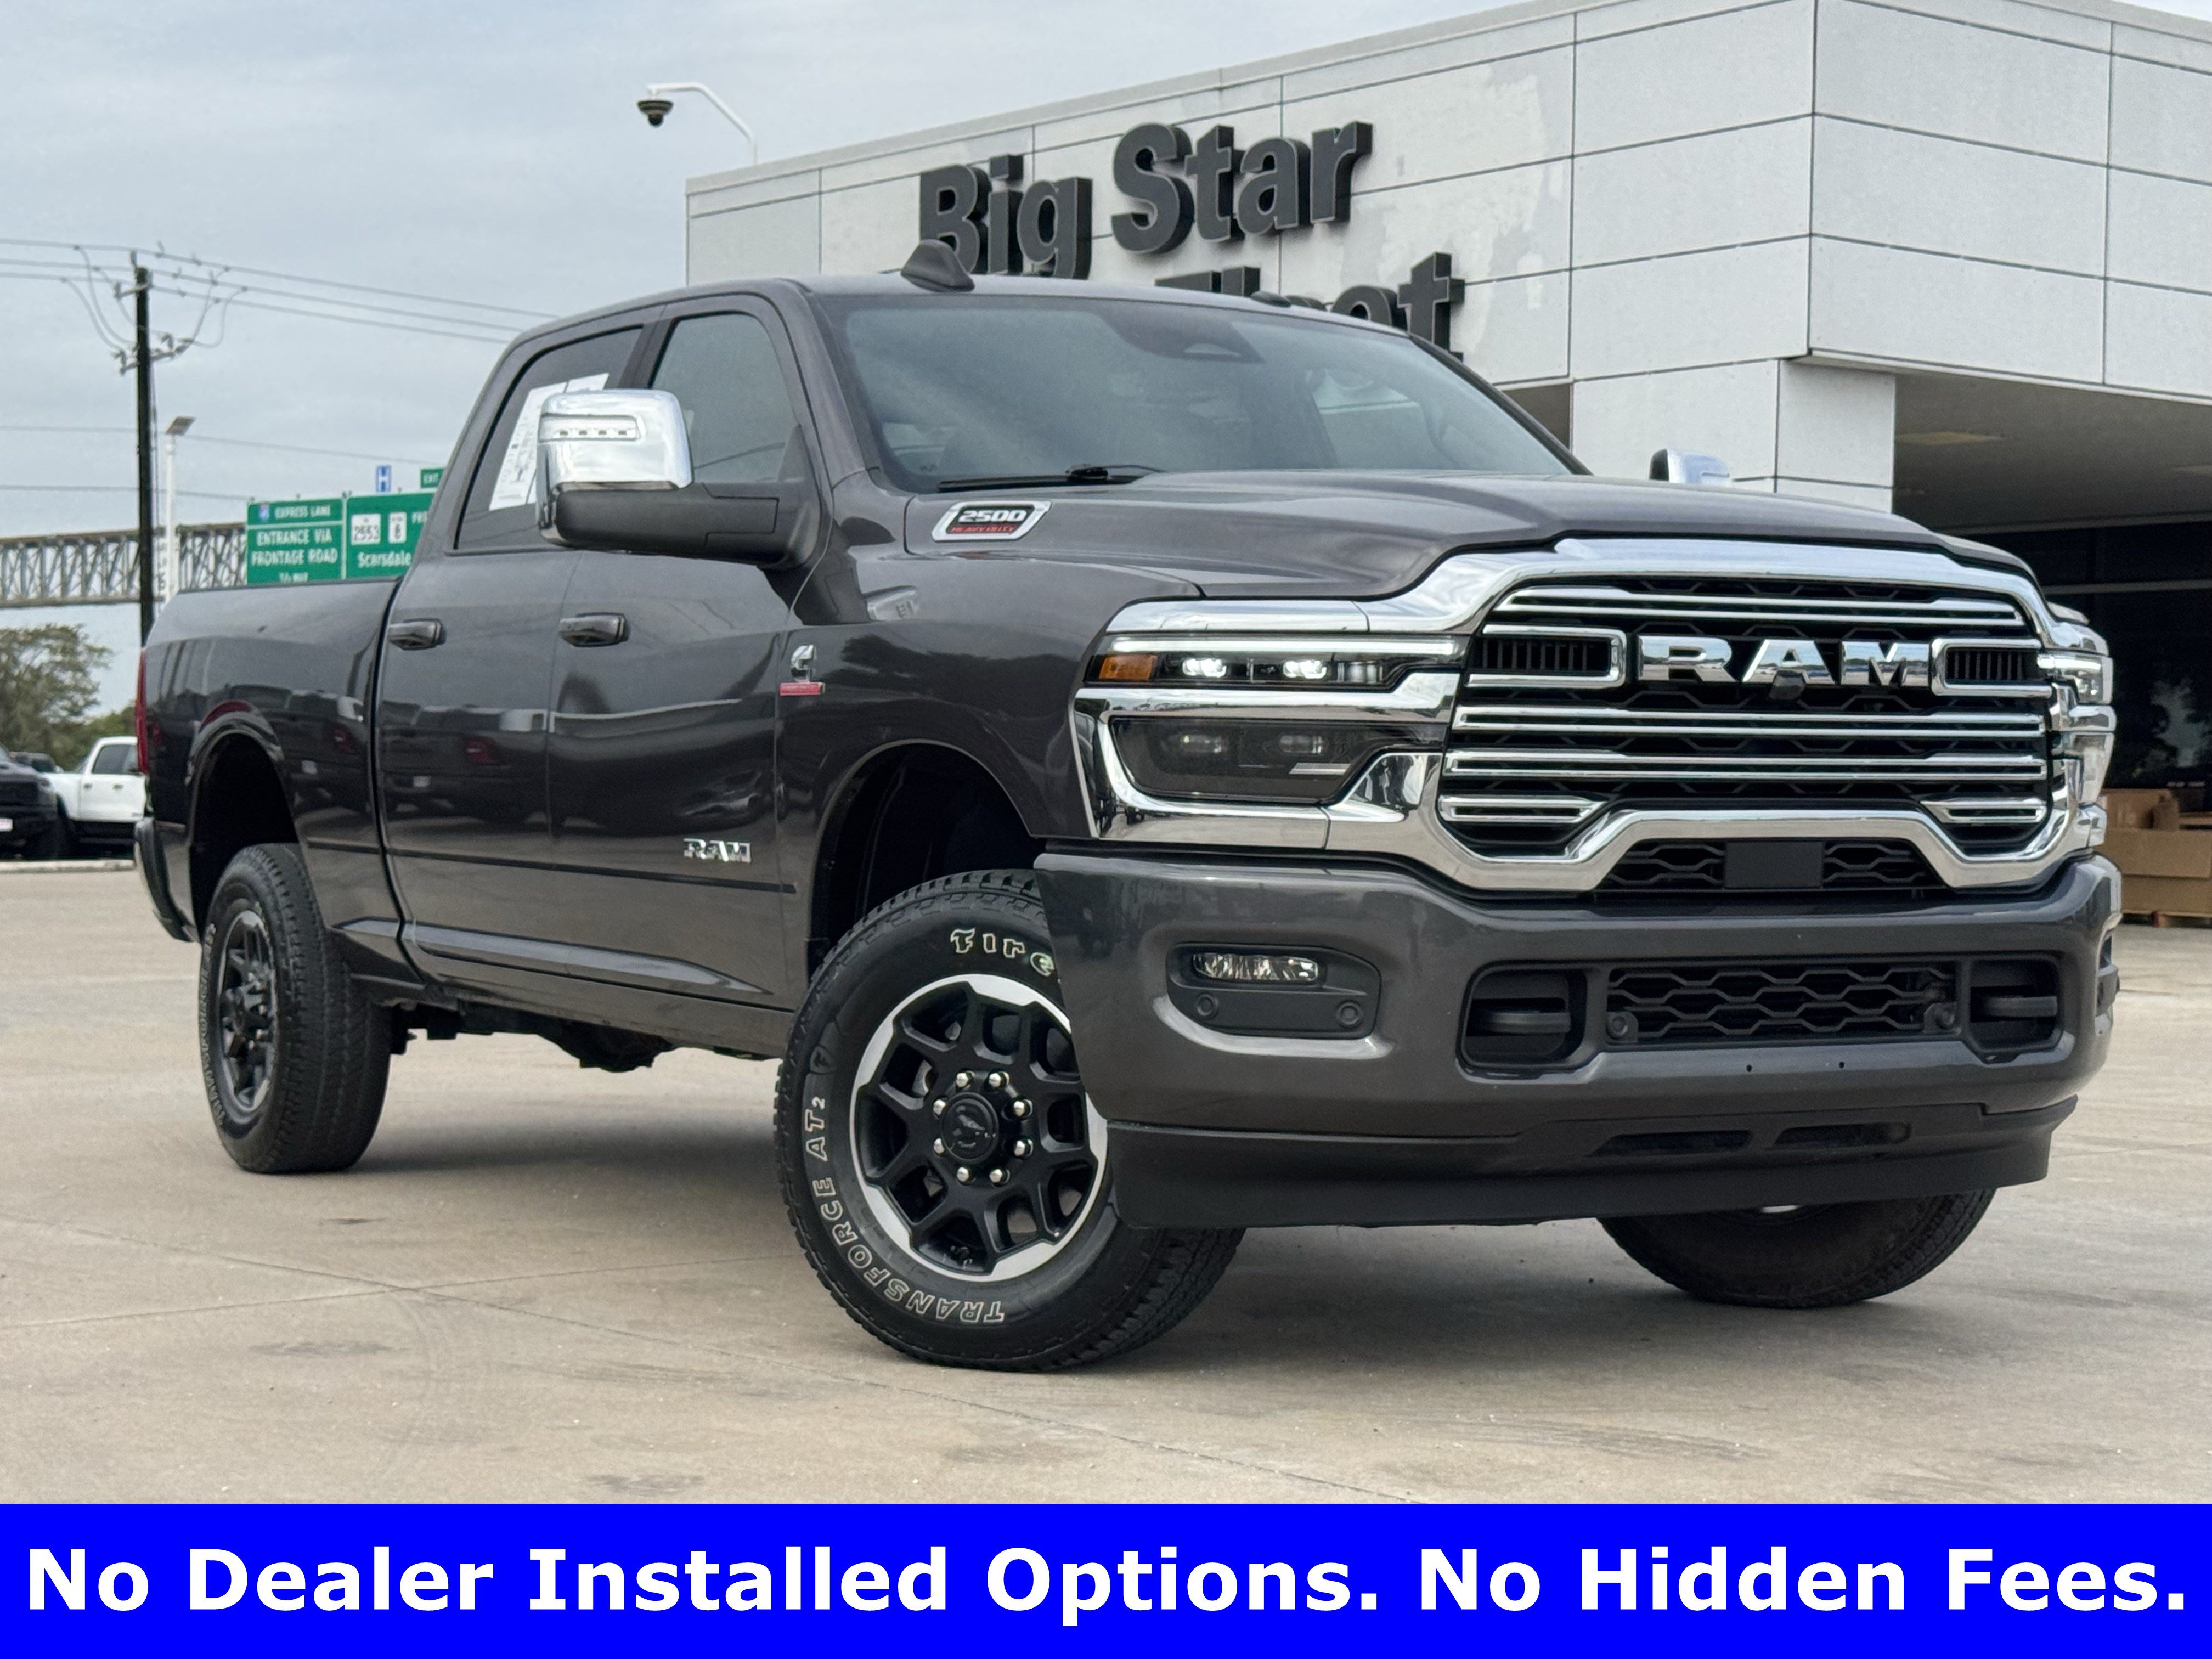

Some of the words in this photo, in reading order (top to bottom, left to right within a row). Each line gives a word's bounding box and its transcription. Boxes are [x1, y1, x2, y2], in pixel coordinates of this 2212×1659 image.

[920, 155, 1090, 280] Big
[1112, 121, 1373, 254] Star
[275, 506, 308, 519] EXPRESS
[310, 505, 331, 517] LANE
[958, 510, 1027, 522] 2500
[257, 529, 310, 546] ENTRANCE
[314, 528, 332, 544] VIA
[251, 550, 305, 567] FRONTAGE
[308, 548, 338, 564] ROAD
[358, 550, 411, 568] Scarsdale
[1637, 635, 1931, 687] RAM
[684, 838, 752, 863] RAM
[812, 1177, 1005, 1323] TRANSFORCE
